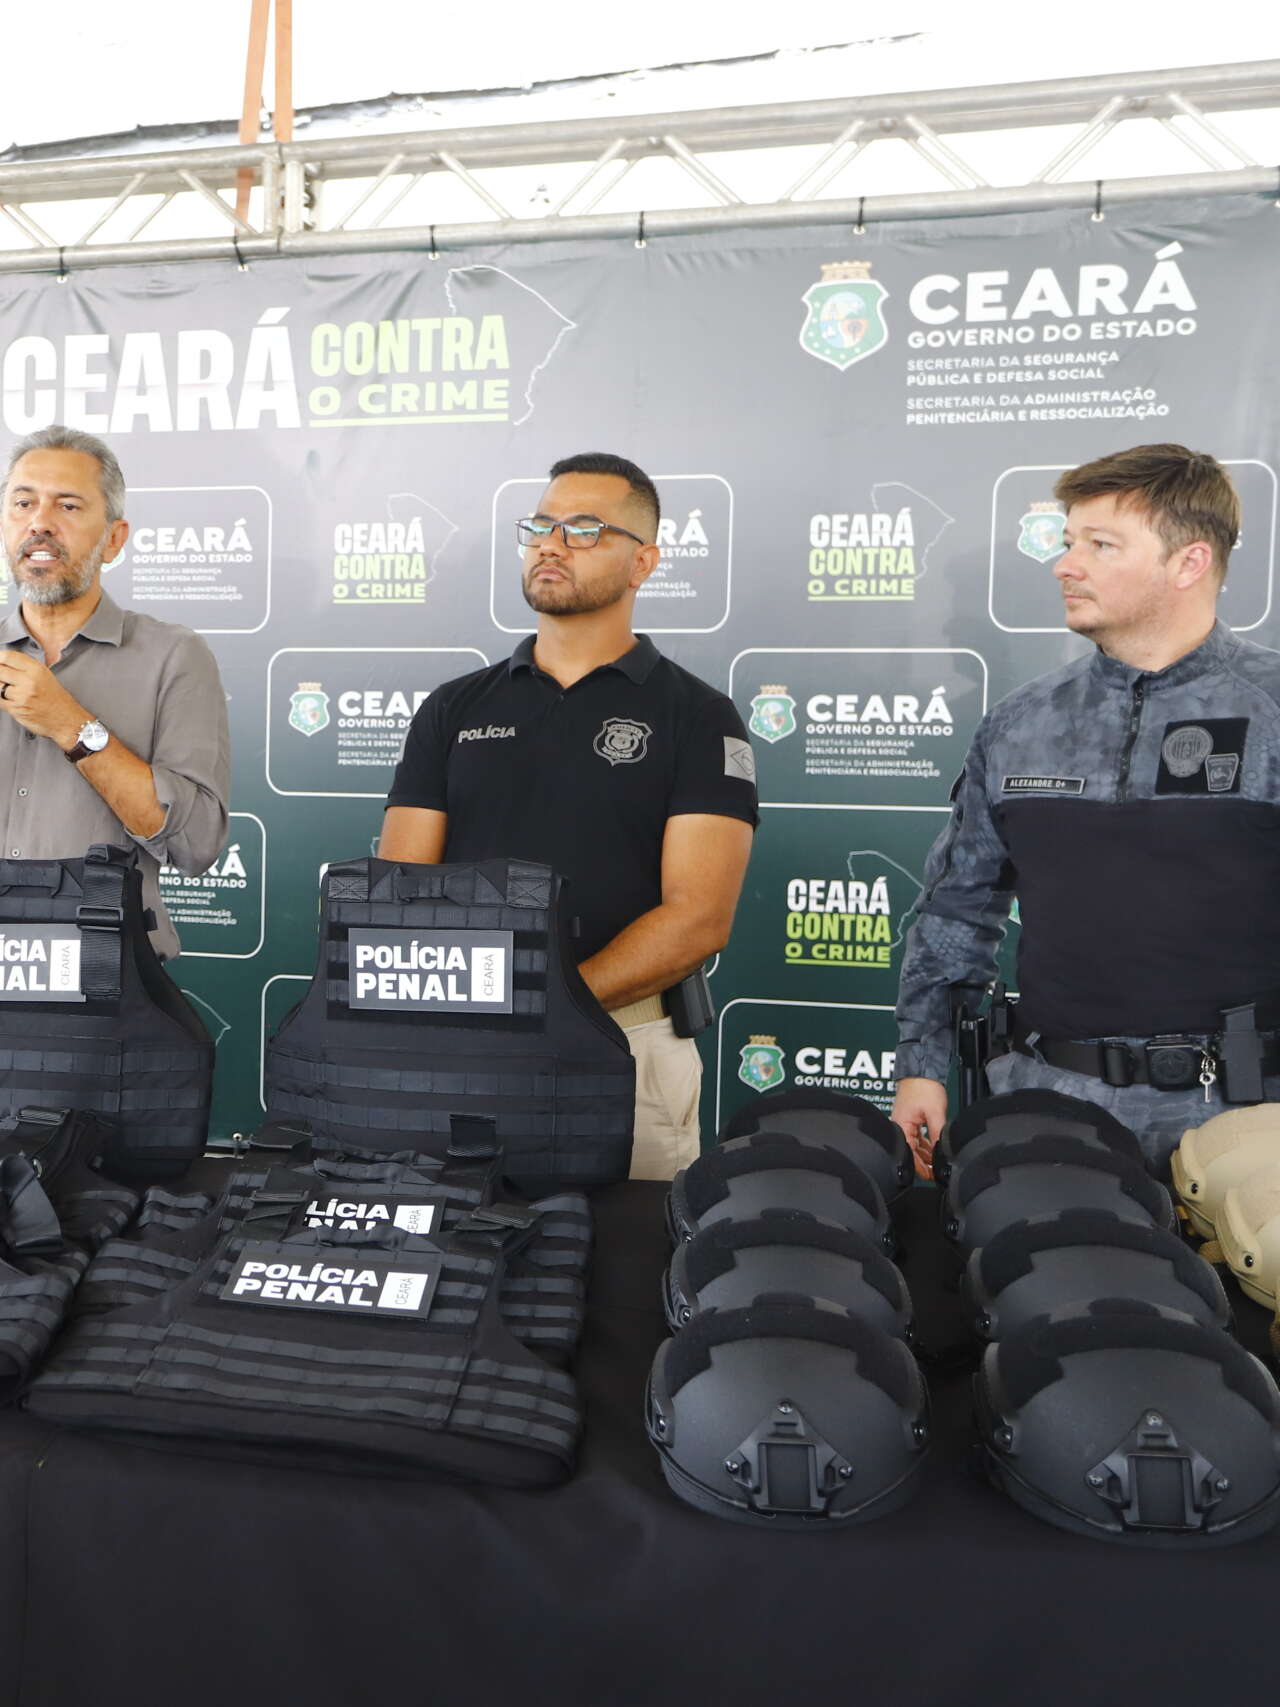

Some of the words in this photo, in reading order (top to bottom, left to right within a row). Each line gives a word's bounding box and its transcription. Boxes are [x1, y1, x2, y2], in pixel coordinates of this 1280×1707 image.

[909, 241, 1197, 325] CEARÁ
[908, 326, 1034, 348] GOVERNO
[1043, 323, 1082, 342] DO
[1090, 318, 1196, 340] ESTADO
[310, 314, 509, 378] CONTRA
[2, 307, 302, 436] CEARÁ
[907, 356, 994, 371] SECRETARIA
[1000, 356, 1020, 367] DA
[1023, 351, 1119, 366] SEGURANÇA
[907, 371, 969, 386] PÚBLICA
[974, 372, 982, 383] E
[986, 370, 1044, 383] DEFESA
[1048, 368, 1104, 380] SOCIAL
[309, 386, 340, 415] O
[356, 379, 509, 414] CRIME
[907, 395, 994, 409] SECRETARIA
[1000, 394, 1020, 405] DA
[1024, 387, 1156, 405] ADMINISTRAÇÃO
[907, 408, 1014, 425] PENITENCIÁRIA
[1018, 410, 1026, 421] E
[1030, 404, 1169, 420] RESSOCIALIZAÇÃO
[133, 518, 252, 552] CEARÁ
[335, 517, 425, 553] CEARÁ
[810, 507, 914, 547] CEARÁ
[133, 554, 187, 563] GOVERNO
[190, 554, 206, 563] DO
[209, 554, 252, 563] ESTADO
[335, 554, 426, 580] CONTRA
[809, 547, 915, 576] CONTRA
[333, 584, 349, 598] O
[356, 584, 425, 598] CRIME
[808, 579, 825, 594] O
[834, 579, 914, 594] CRIME
[807, 686, 952, 723] CEARÁ
[338, 718, 395, 728] GOVERNO
[458, 724, 515, 743] POLÍCIA
[806, 724, 871, 735] GOVERNO
[876, 725, 895, 735] DO
[900, 726, 953, 736] ESTADO
[1010, 779, 1052, 787] ALEXANDRE
[184, 877, 200, 886] DO
[203, 878, 247, 888] ESTADO
[787, 876, 890, 915] CEARÁ
[786, 912, 891, 942] CONTRA
[356, 941, 467, 970] POLÍCIA
[785, 942, 802, 957] O
[812, 944, 891, 962] CRIME
[356, 973, 468, 1001] PENAL
[795, 1076, 860, 1089] GOVERNO
[864, 1080, 883, 1090] DO
[306, 1198, 390, 1219] LÍCIA
[241, 1262, 378, 1287] POLÍCIA
[232, 1278, 373, 1306] PENAL
